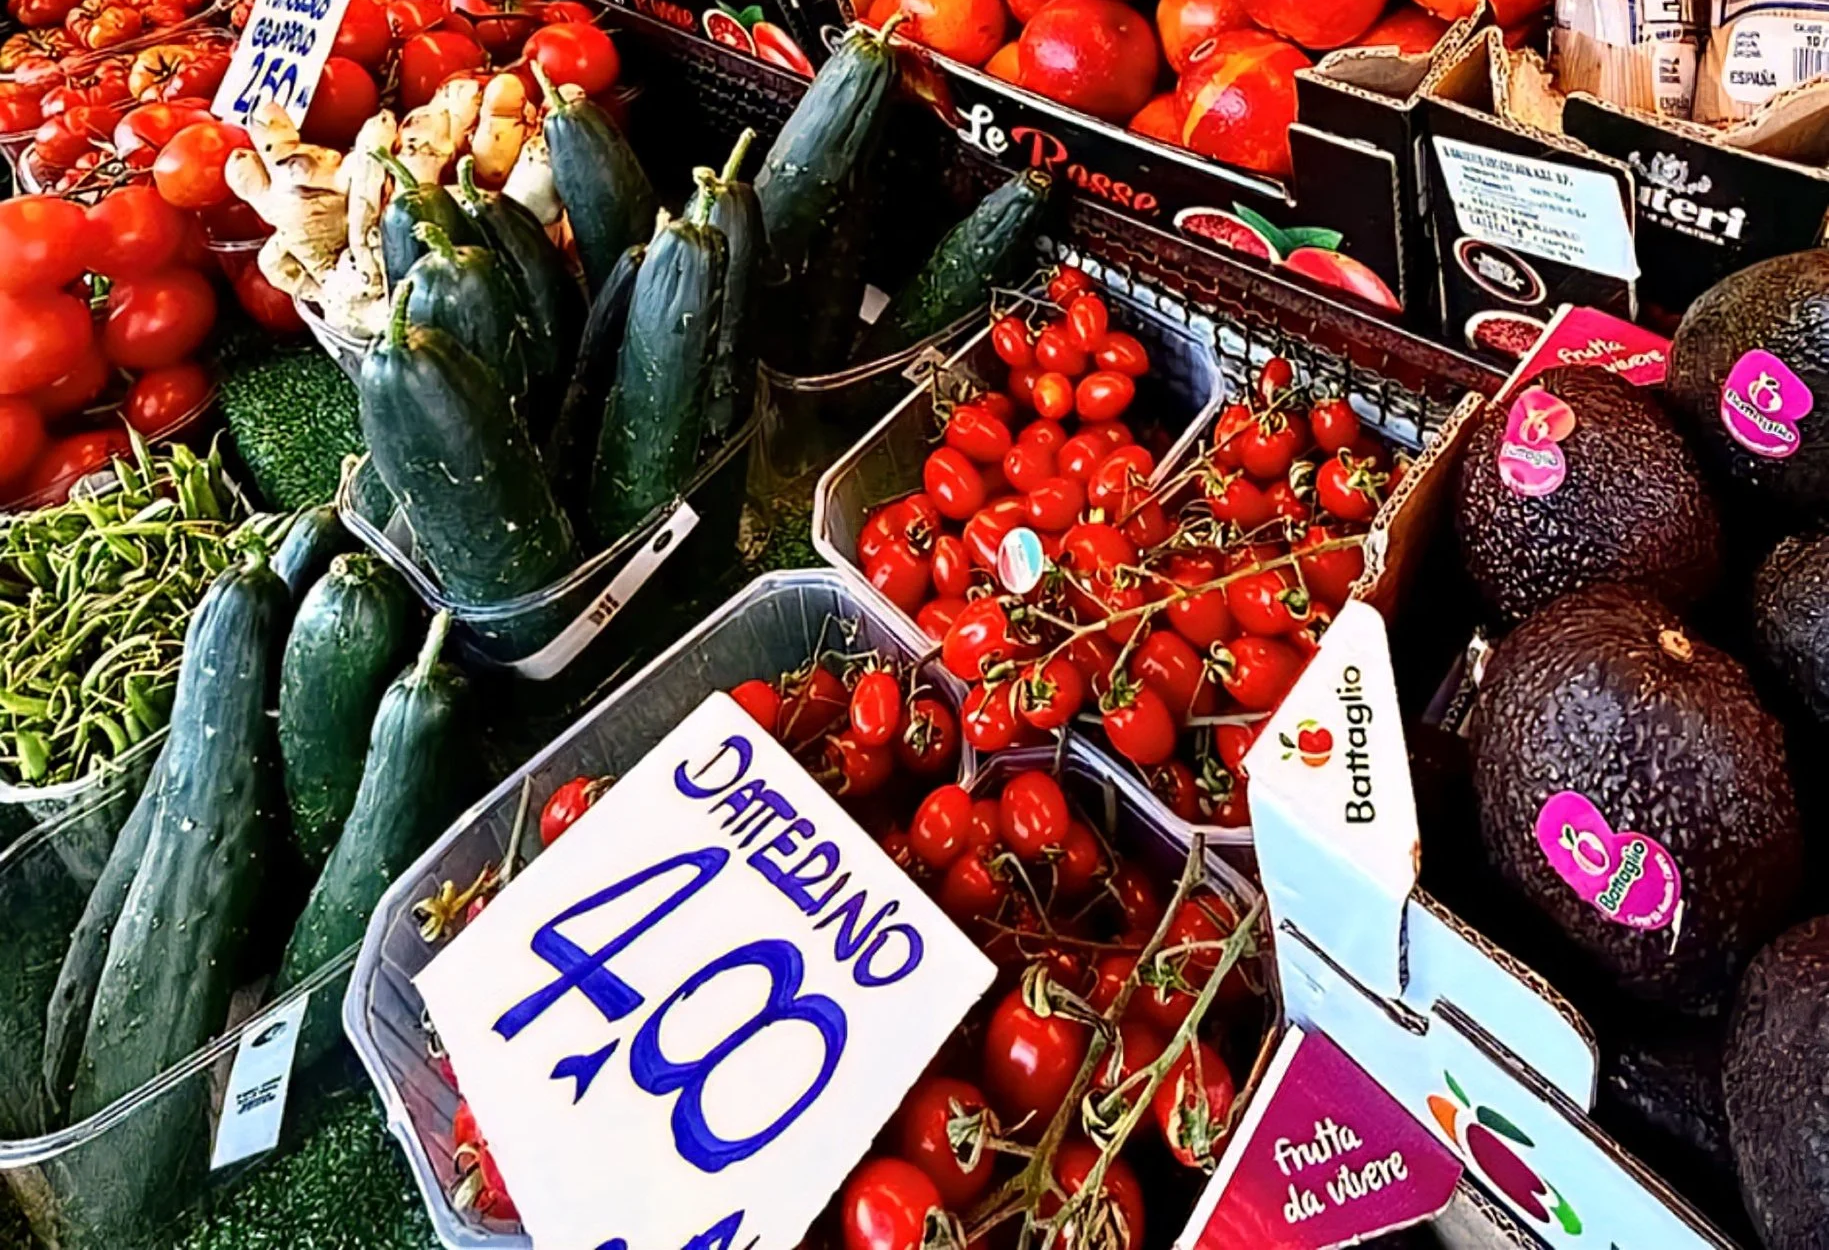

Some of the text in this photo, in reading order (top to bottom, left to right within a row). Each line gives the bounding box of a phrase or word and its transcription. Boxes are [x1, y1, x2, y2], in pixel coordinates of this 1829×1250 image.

[956, 103, 1009, 158] Le
[1335, 665, 1376, 824] Battaglio
[674, 735, 925, 988] DATTERINO
[1599, 841, 1646, 912] Battaglio
[1273, 1116, 1363, 1176] frutta
[1283, 1150, 1409, 1224] da vivere
